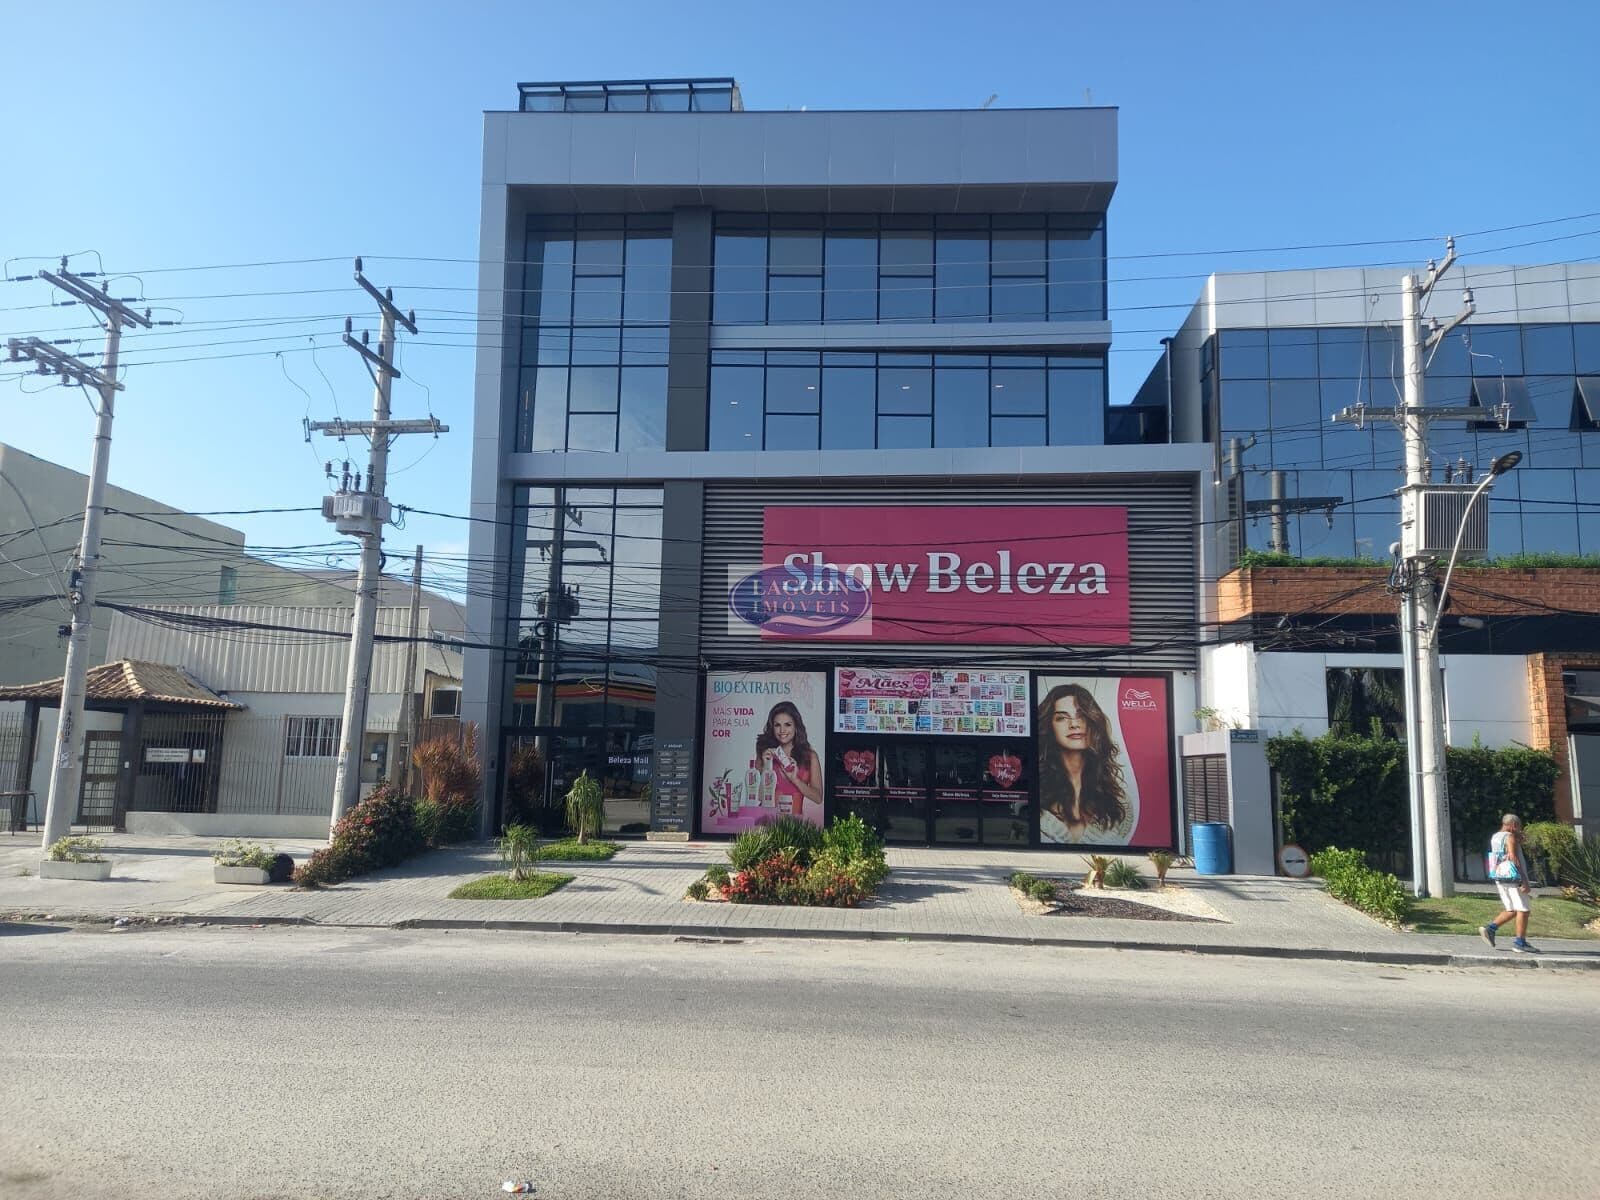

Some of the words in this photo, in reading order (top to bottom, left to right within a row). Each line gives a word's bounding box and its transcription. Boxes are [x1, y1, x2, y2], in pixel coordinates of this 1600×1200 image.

[783, 551, 919, 594] Show
[926, 550, 1110, 595] Beleza
[1121, 700, 1157, 708] WELLA
[713, 707, 731, 716] MAIS
[733, 707, 754, 716] VIDA
[712, 719, 732, 727] PARA
[734, 719, 750, 727] SUA
[712, 729, 731, 738] COR
[608, 756, 632, 764] Beleza
[633, 756, 649, 764] Mall
